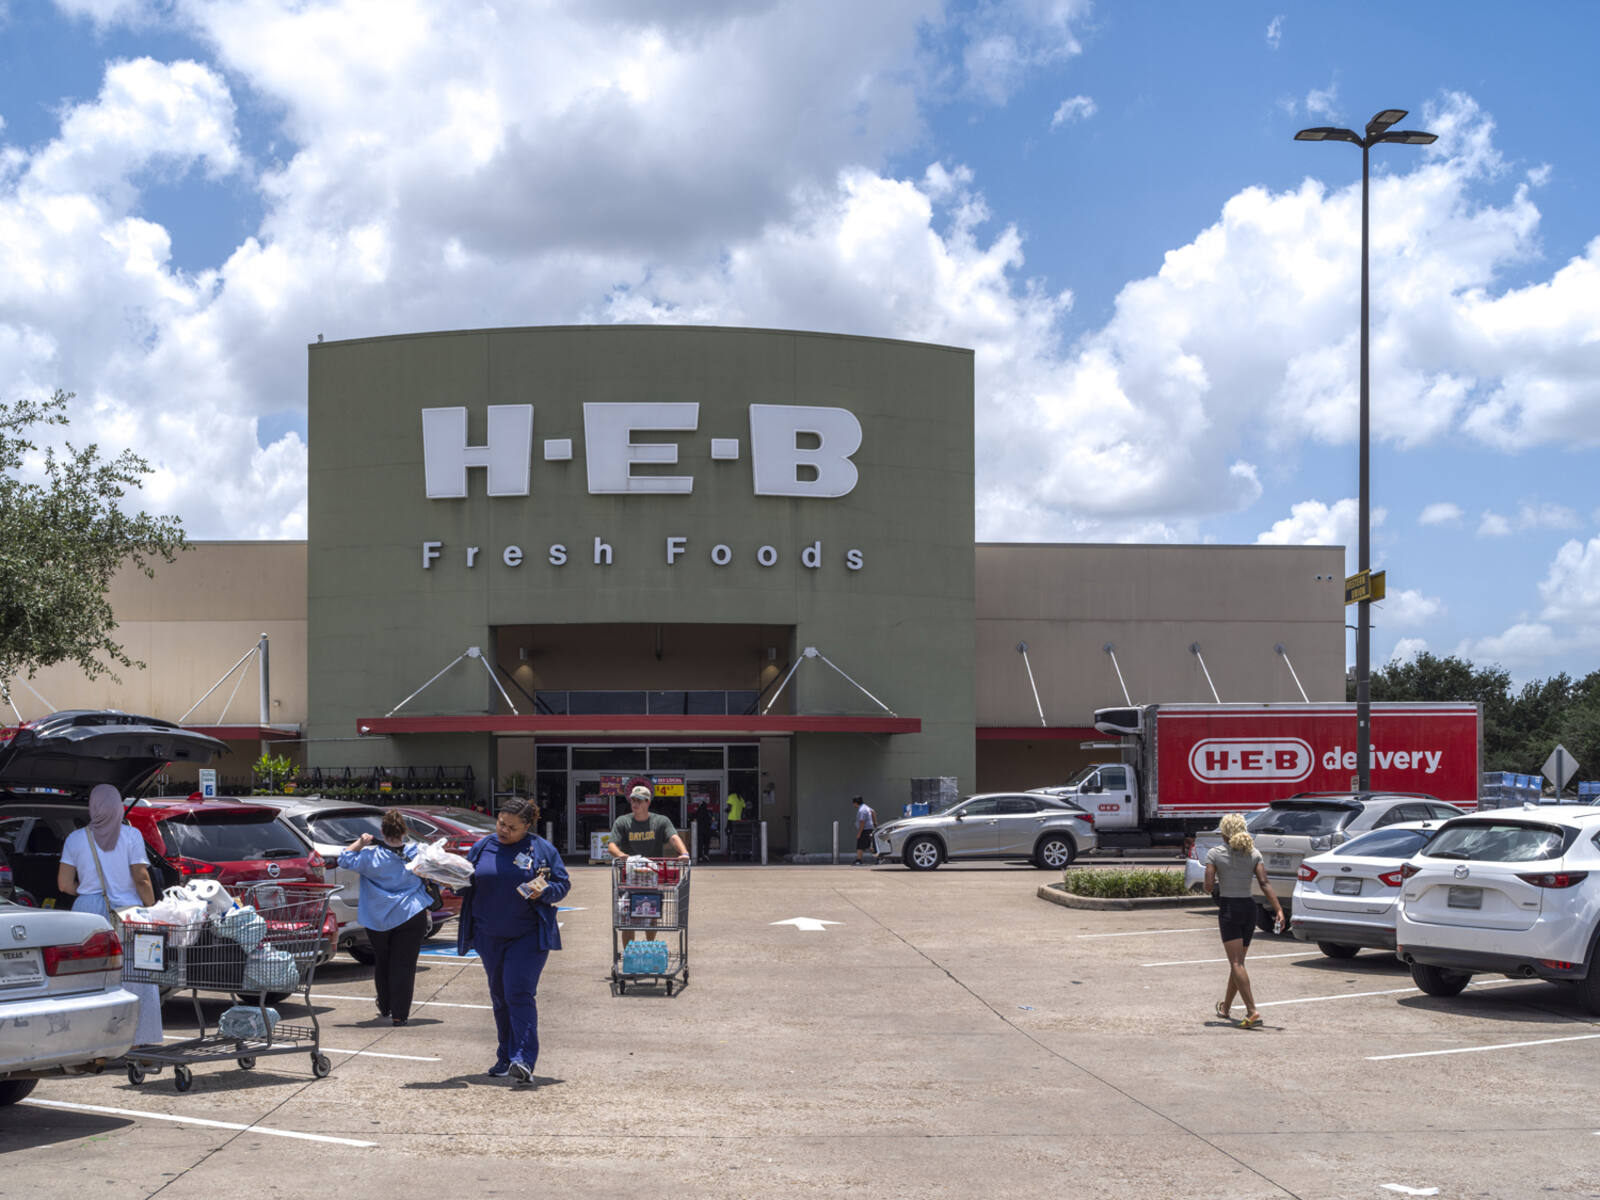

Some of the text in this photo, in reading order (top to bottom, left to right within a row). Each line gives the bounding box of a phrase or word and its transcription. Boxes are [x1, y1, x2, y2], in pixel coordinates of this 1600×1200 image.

[422, 402, 863, 498] H-E-B
[422, 535, 865, 571] Fresh Foods
[1205, 744, 1442, 774] H-E-B deivery
[628, 831, 655, 841] BAYLOR
[3, 951, 24, 960] TEXAS
